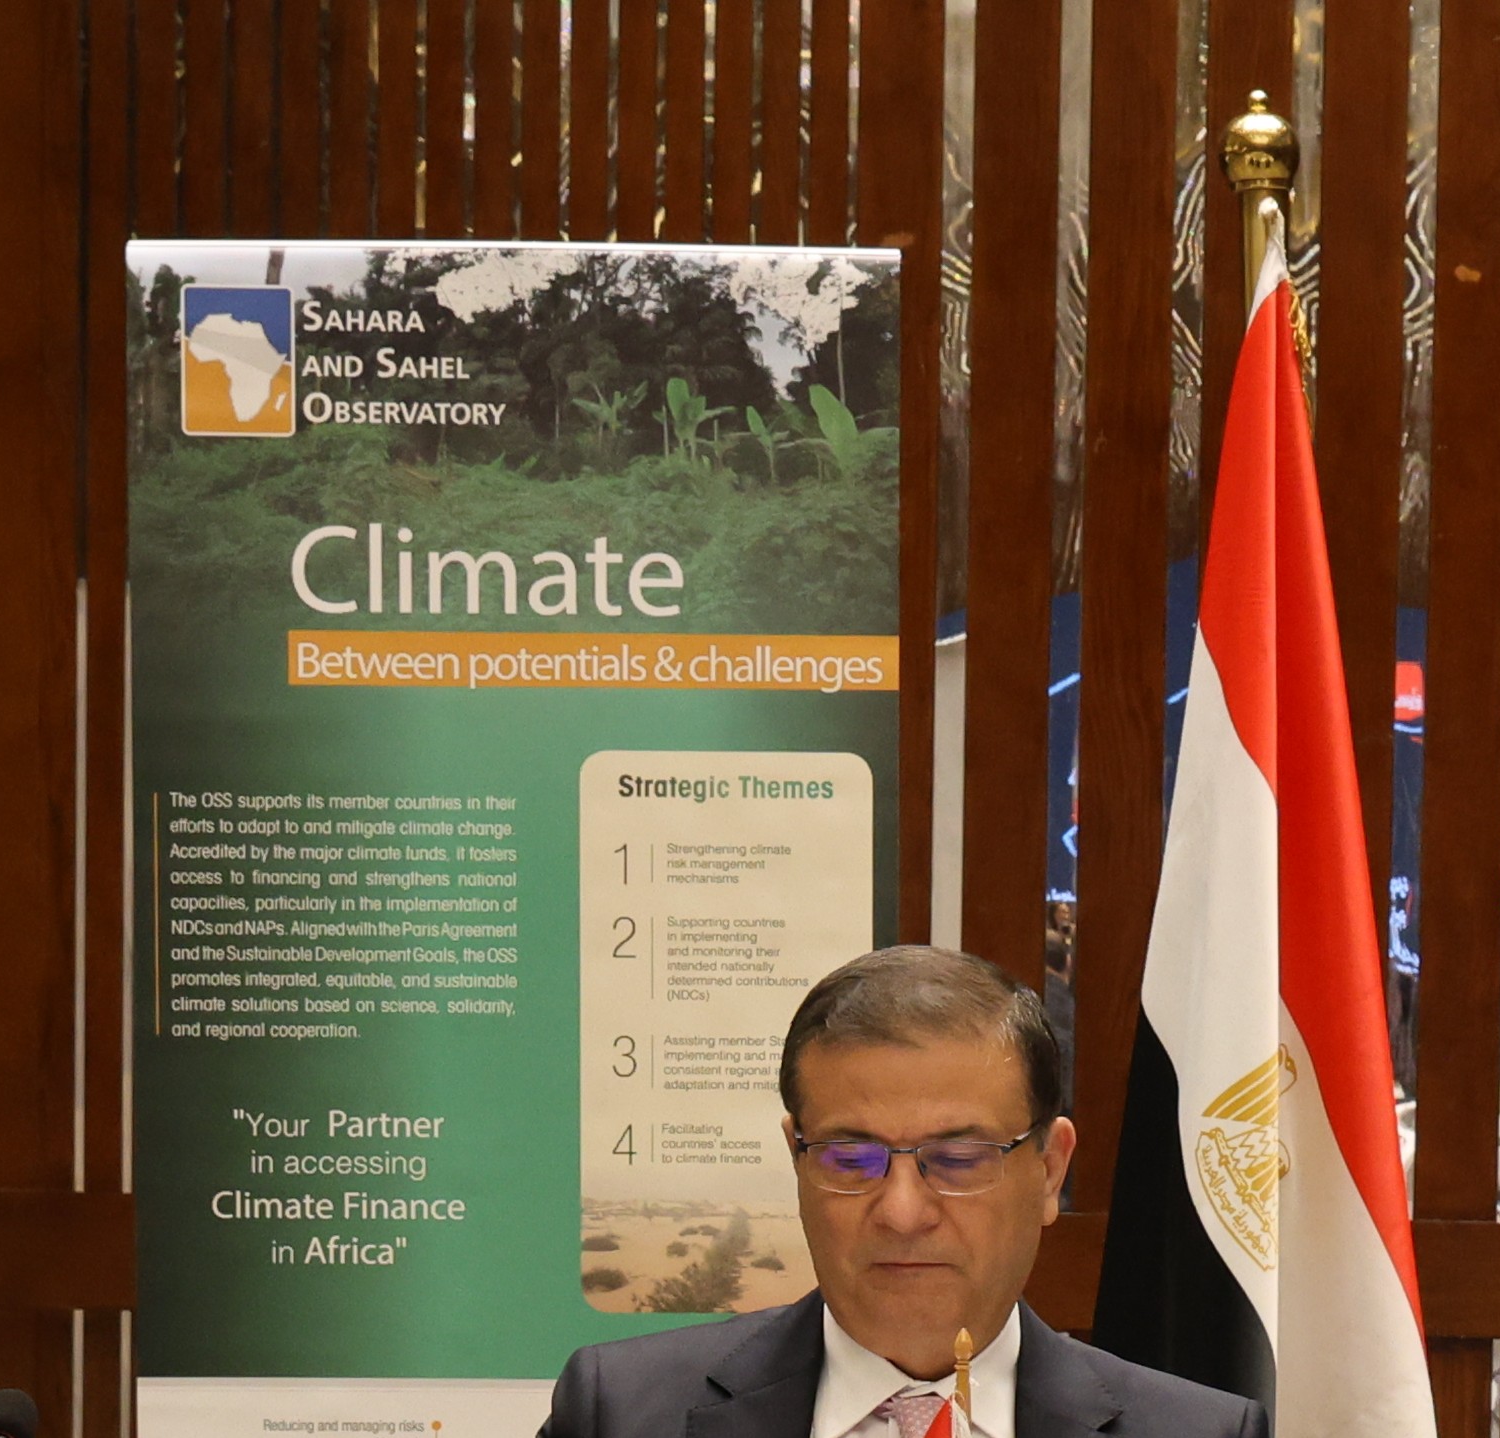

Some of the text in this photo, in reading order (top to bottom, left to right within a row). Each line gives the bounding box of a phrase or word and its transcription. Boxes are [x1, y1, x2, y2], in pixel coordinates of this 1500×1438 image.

[292, 523, 683, 616] Climate
[298, 642, 882, 692] Between potentials & challenges
[619, 774, 833, 803] Strategic Themes
[614, 844, 627, 885] 1
[612, 916, 636, 958] 2
[612, 1035, 637, 1078] 3
[234, 1109, 444, 1138] "Your Partner
[612, 1124, 637, 1165] 4
[251, 1150, 426, 1181] in accessing
[212, 1191, 465, 1220] Climate Finance
[272, 1235, 407, 1264] in Africa"
[263, 1419, 425, 1435] Reducing and managing risks
